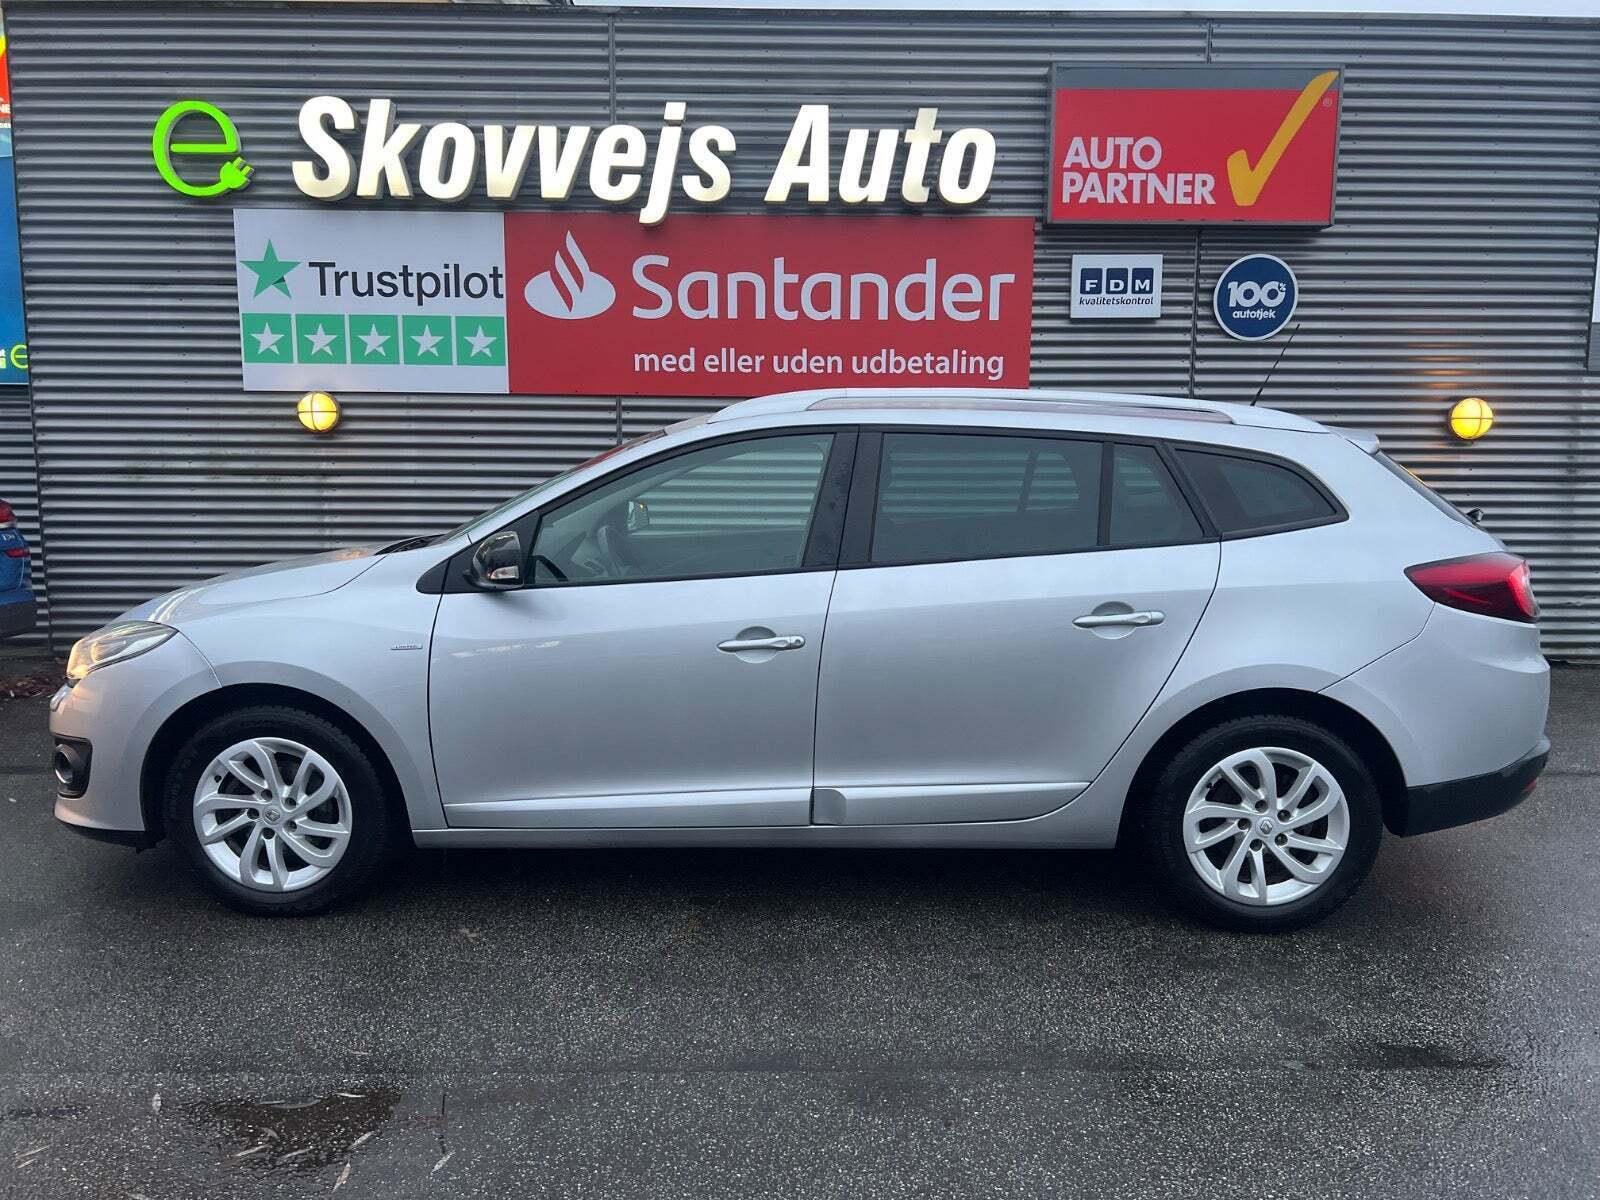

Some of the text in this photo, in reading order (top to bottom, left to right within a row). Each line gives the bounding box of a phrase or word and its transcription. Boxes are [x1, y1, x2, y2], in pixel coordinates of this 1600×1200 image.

[292, 95, 997, 226] Skovvejs Auto
[1062, 136, 1163, 170] AUTO
[1062, 171, 1217, 206] PARTNER
[308, 260, 505, 307] Trustpilot
[632, 254, 1017, 322] Santander
[1079, 296, 1154, 306] kvalitetskontrol
[1084, 279, 1151, 292] FDM
[1232, 308, 1277, 321] autotjek
[634, 347, 1005, 382] med eller uden udbetaling
